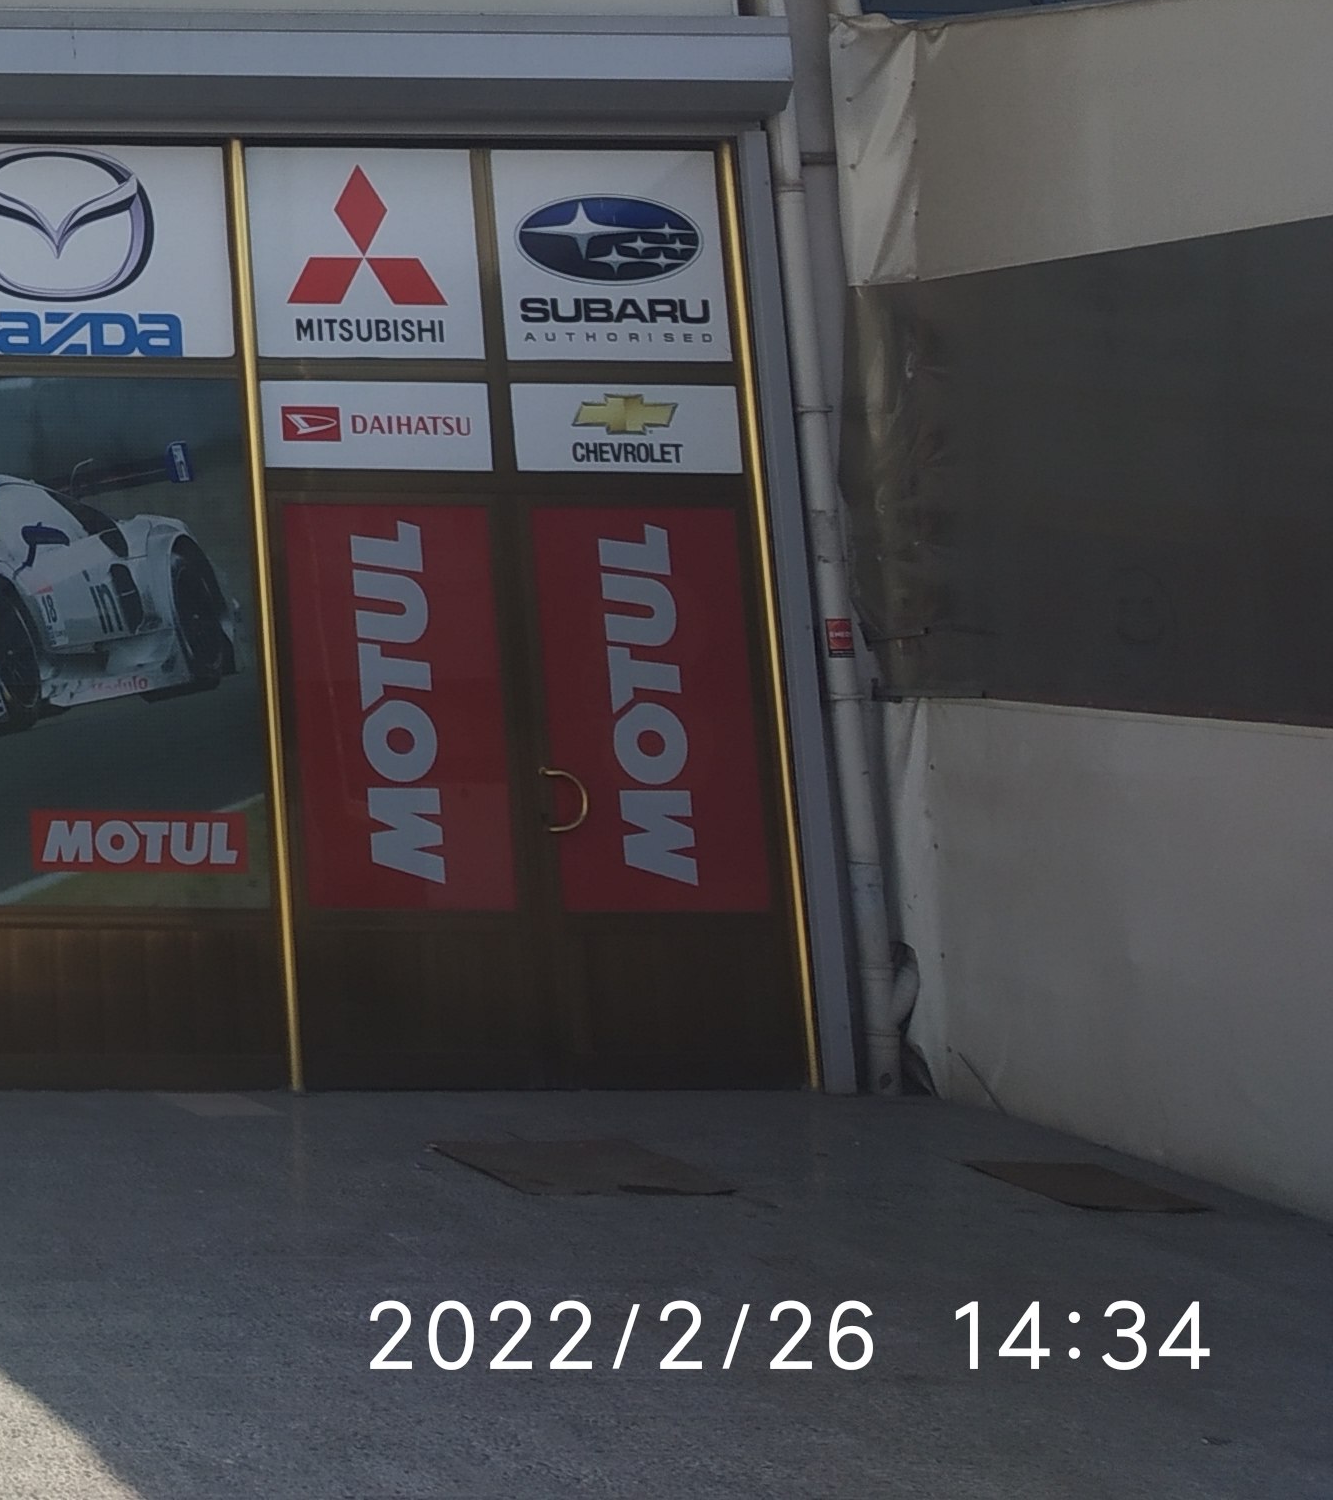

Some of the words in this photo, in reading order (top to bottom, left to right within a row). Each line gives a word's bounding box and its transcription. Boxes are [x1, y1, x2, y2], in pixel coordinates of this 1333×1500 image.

[520, 297, 710, 325] SUBARU
[295, 318, 445, 343] MITSUBISHI
[524, 332, 713, 344] AUTHORISED
[351, 414, 472, 437] DAIHATSU
[572, 442, 684, 464] CHEVROLET
[349, 519, 446, 884] MOTUL
[598, 522, 700, 887] MOTUL
[40, 819, 239, 865] MOTUL
